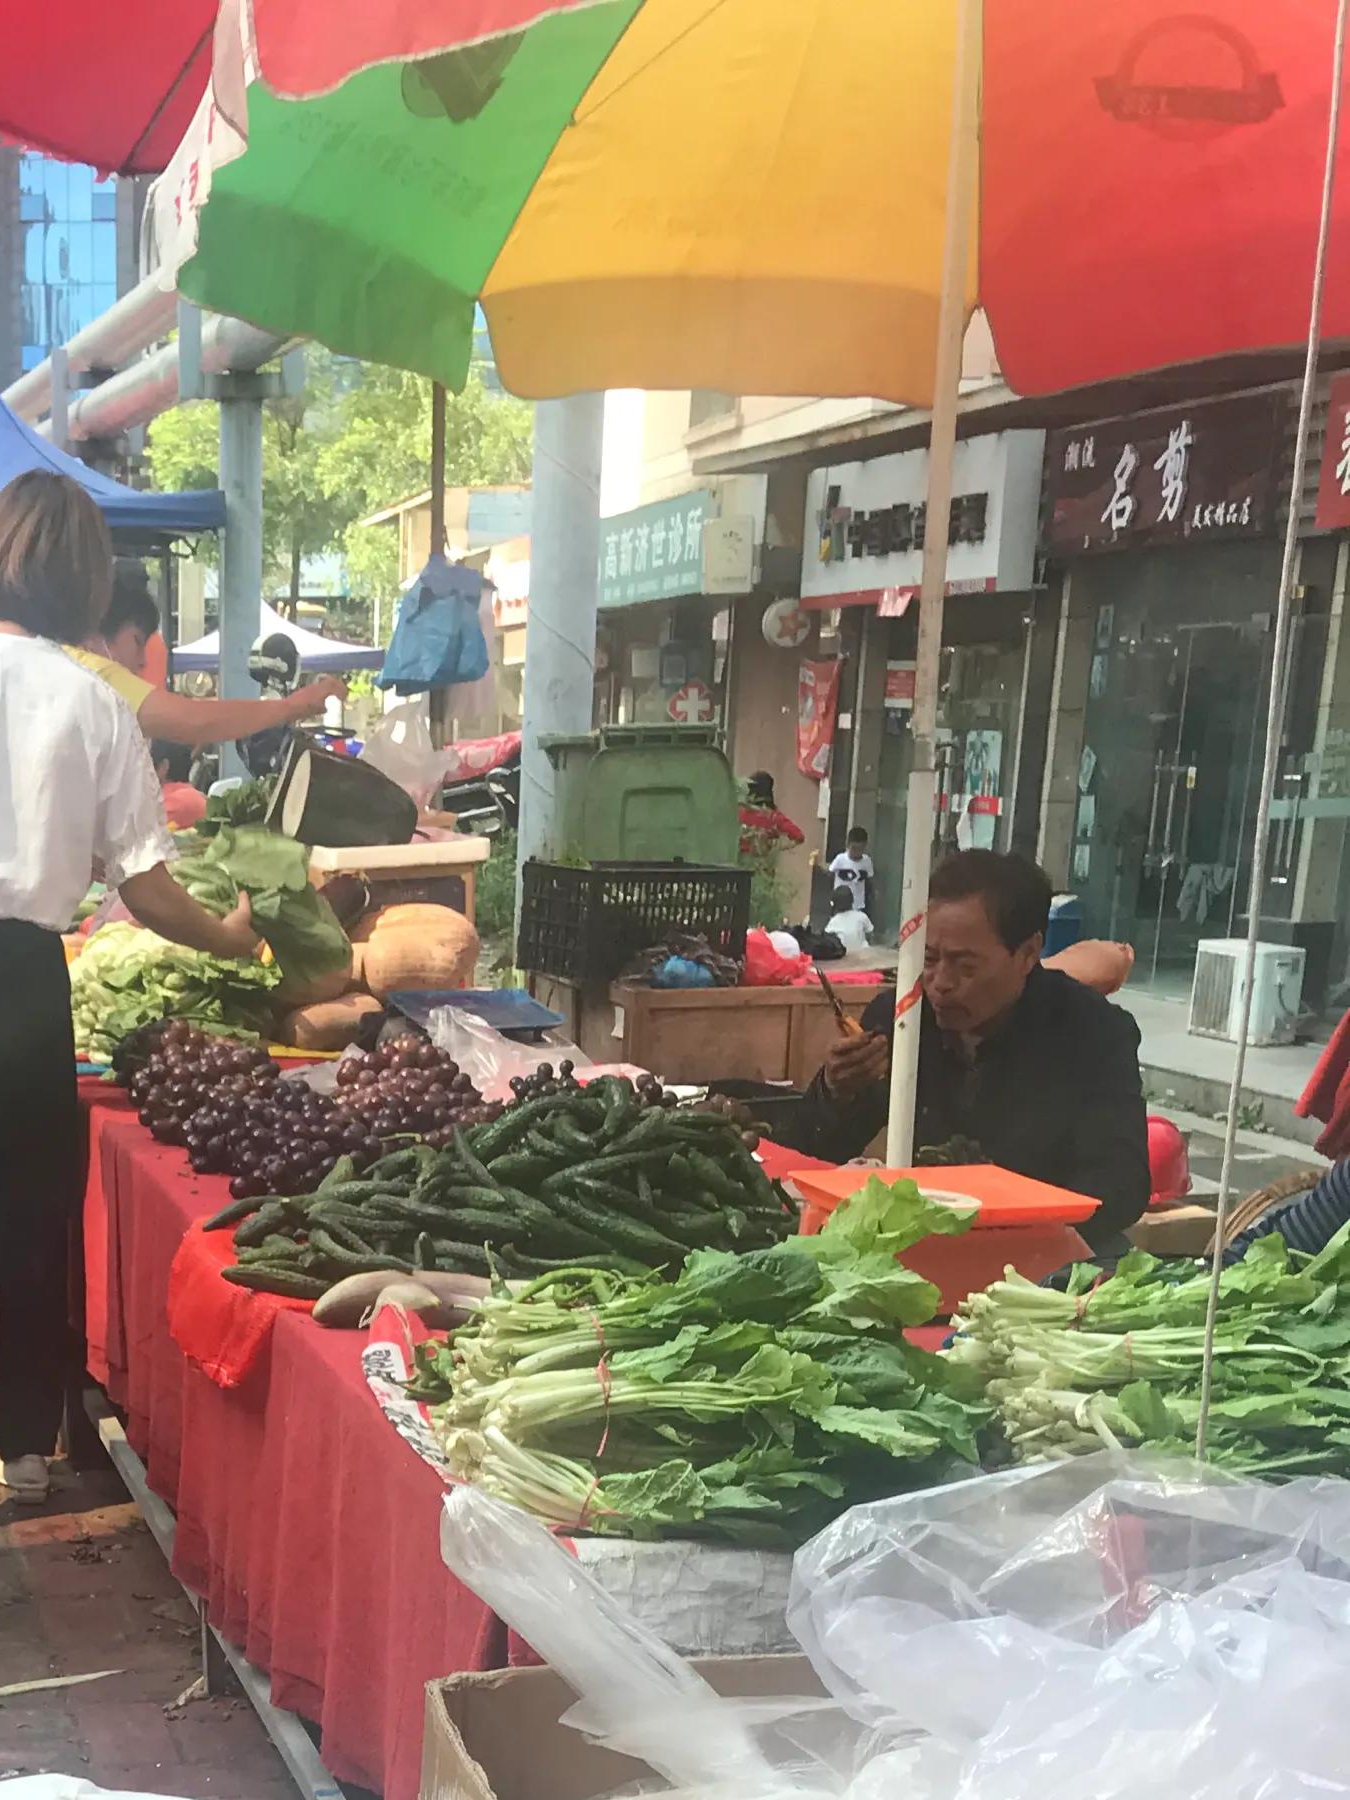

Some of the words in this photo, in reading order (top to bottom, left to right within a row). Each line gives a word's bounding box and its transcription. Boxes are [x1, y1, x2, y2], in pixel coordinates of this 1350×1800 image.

[604, 507, 703, 580] 高新济世诊所
